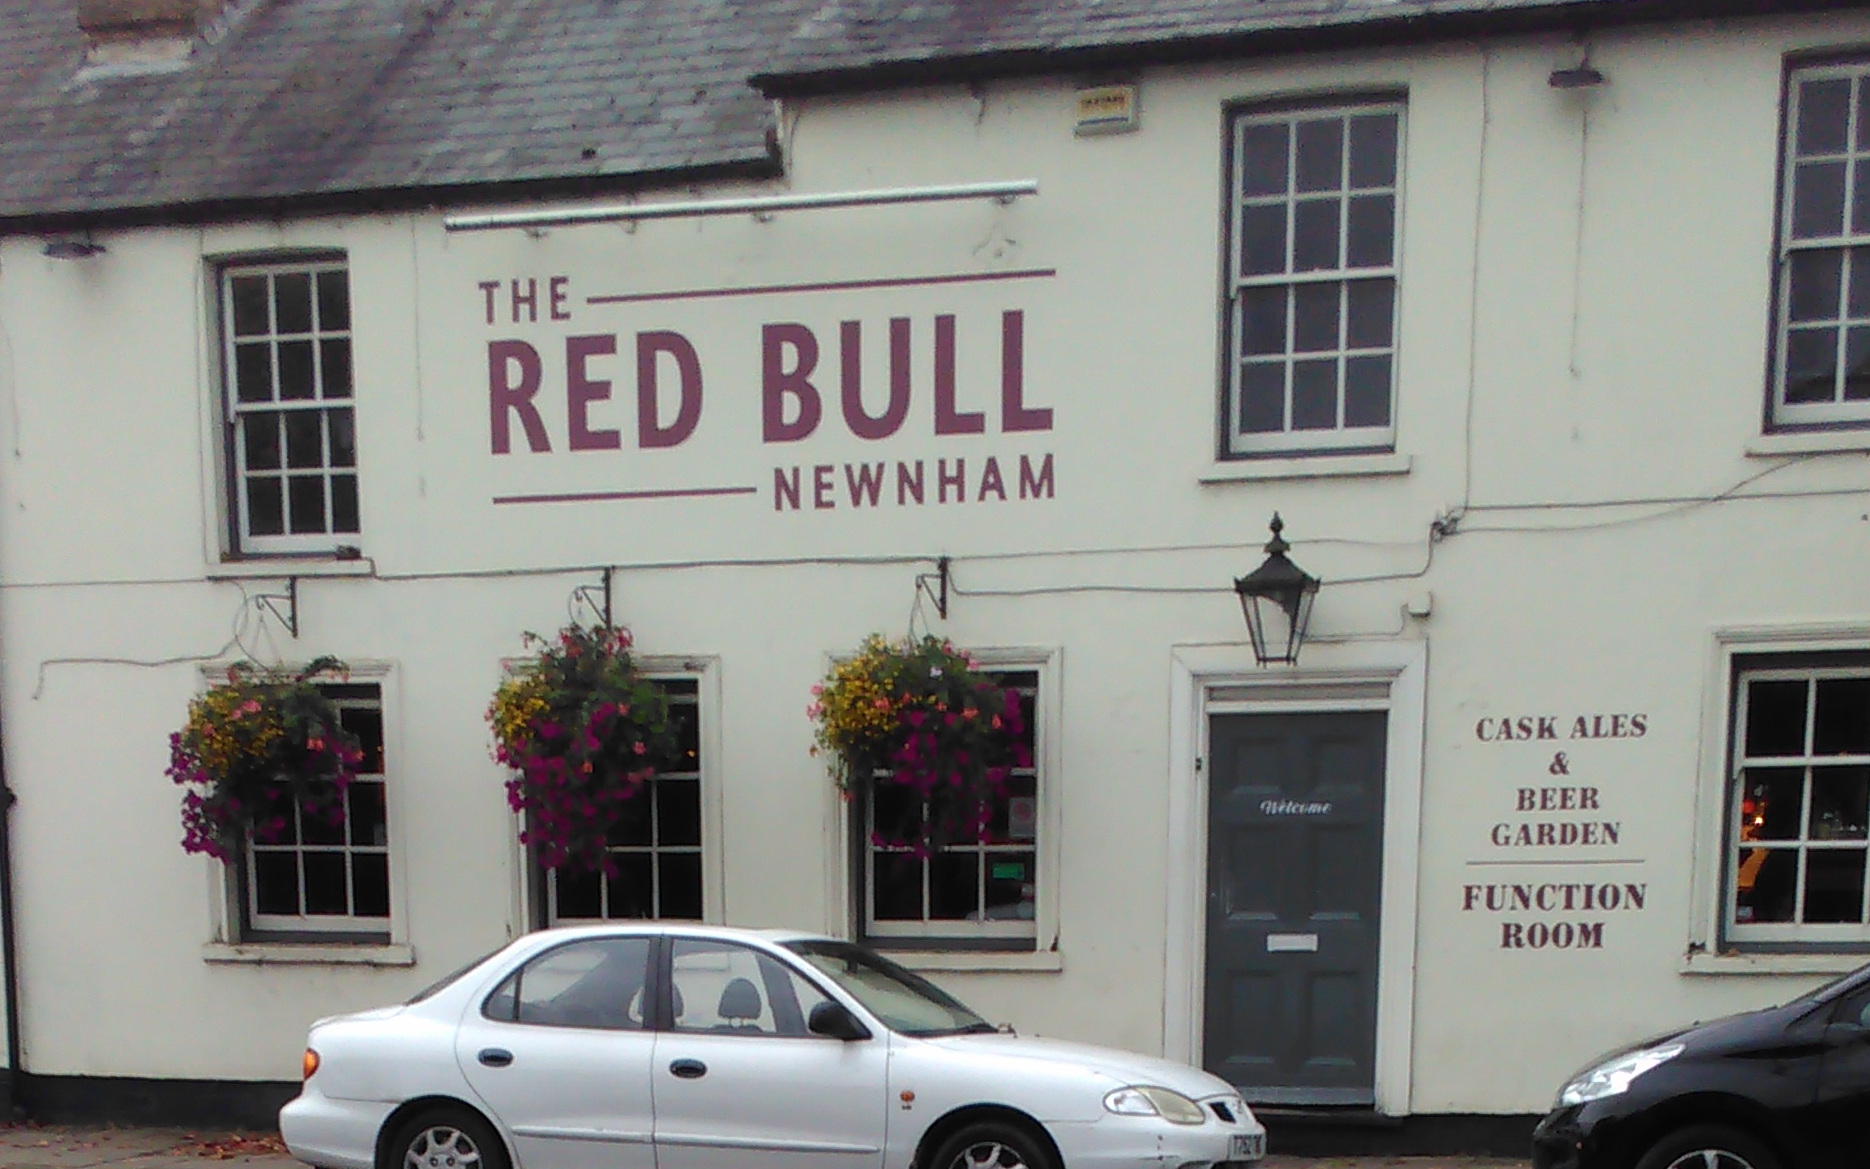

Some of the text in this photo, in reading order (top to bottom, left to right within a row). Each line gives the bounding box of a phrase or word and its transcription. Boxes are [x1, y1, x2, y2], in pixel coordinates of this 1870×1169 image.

[478, 276, 571, 324] THE
[487, 309, 1053, 455] RED BULL
[774, 453, 1054, 511] NEWNHAM
[1476, 714, 1648, 741] CASK ALES
[1549, 751, 1570, 775] &
[1260, 800, 1332, 815] Welcome
[1515, 787, 1600, 811] BEER
[1491, 821, 1621, 847] GARDEN
[1462, 883, 1647, 911] FUNCTION
[1500, 922, 1606, 949] ROOM
